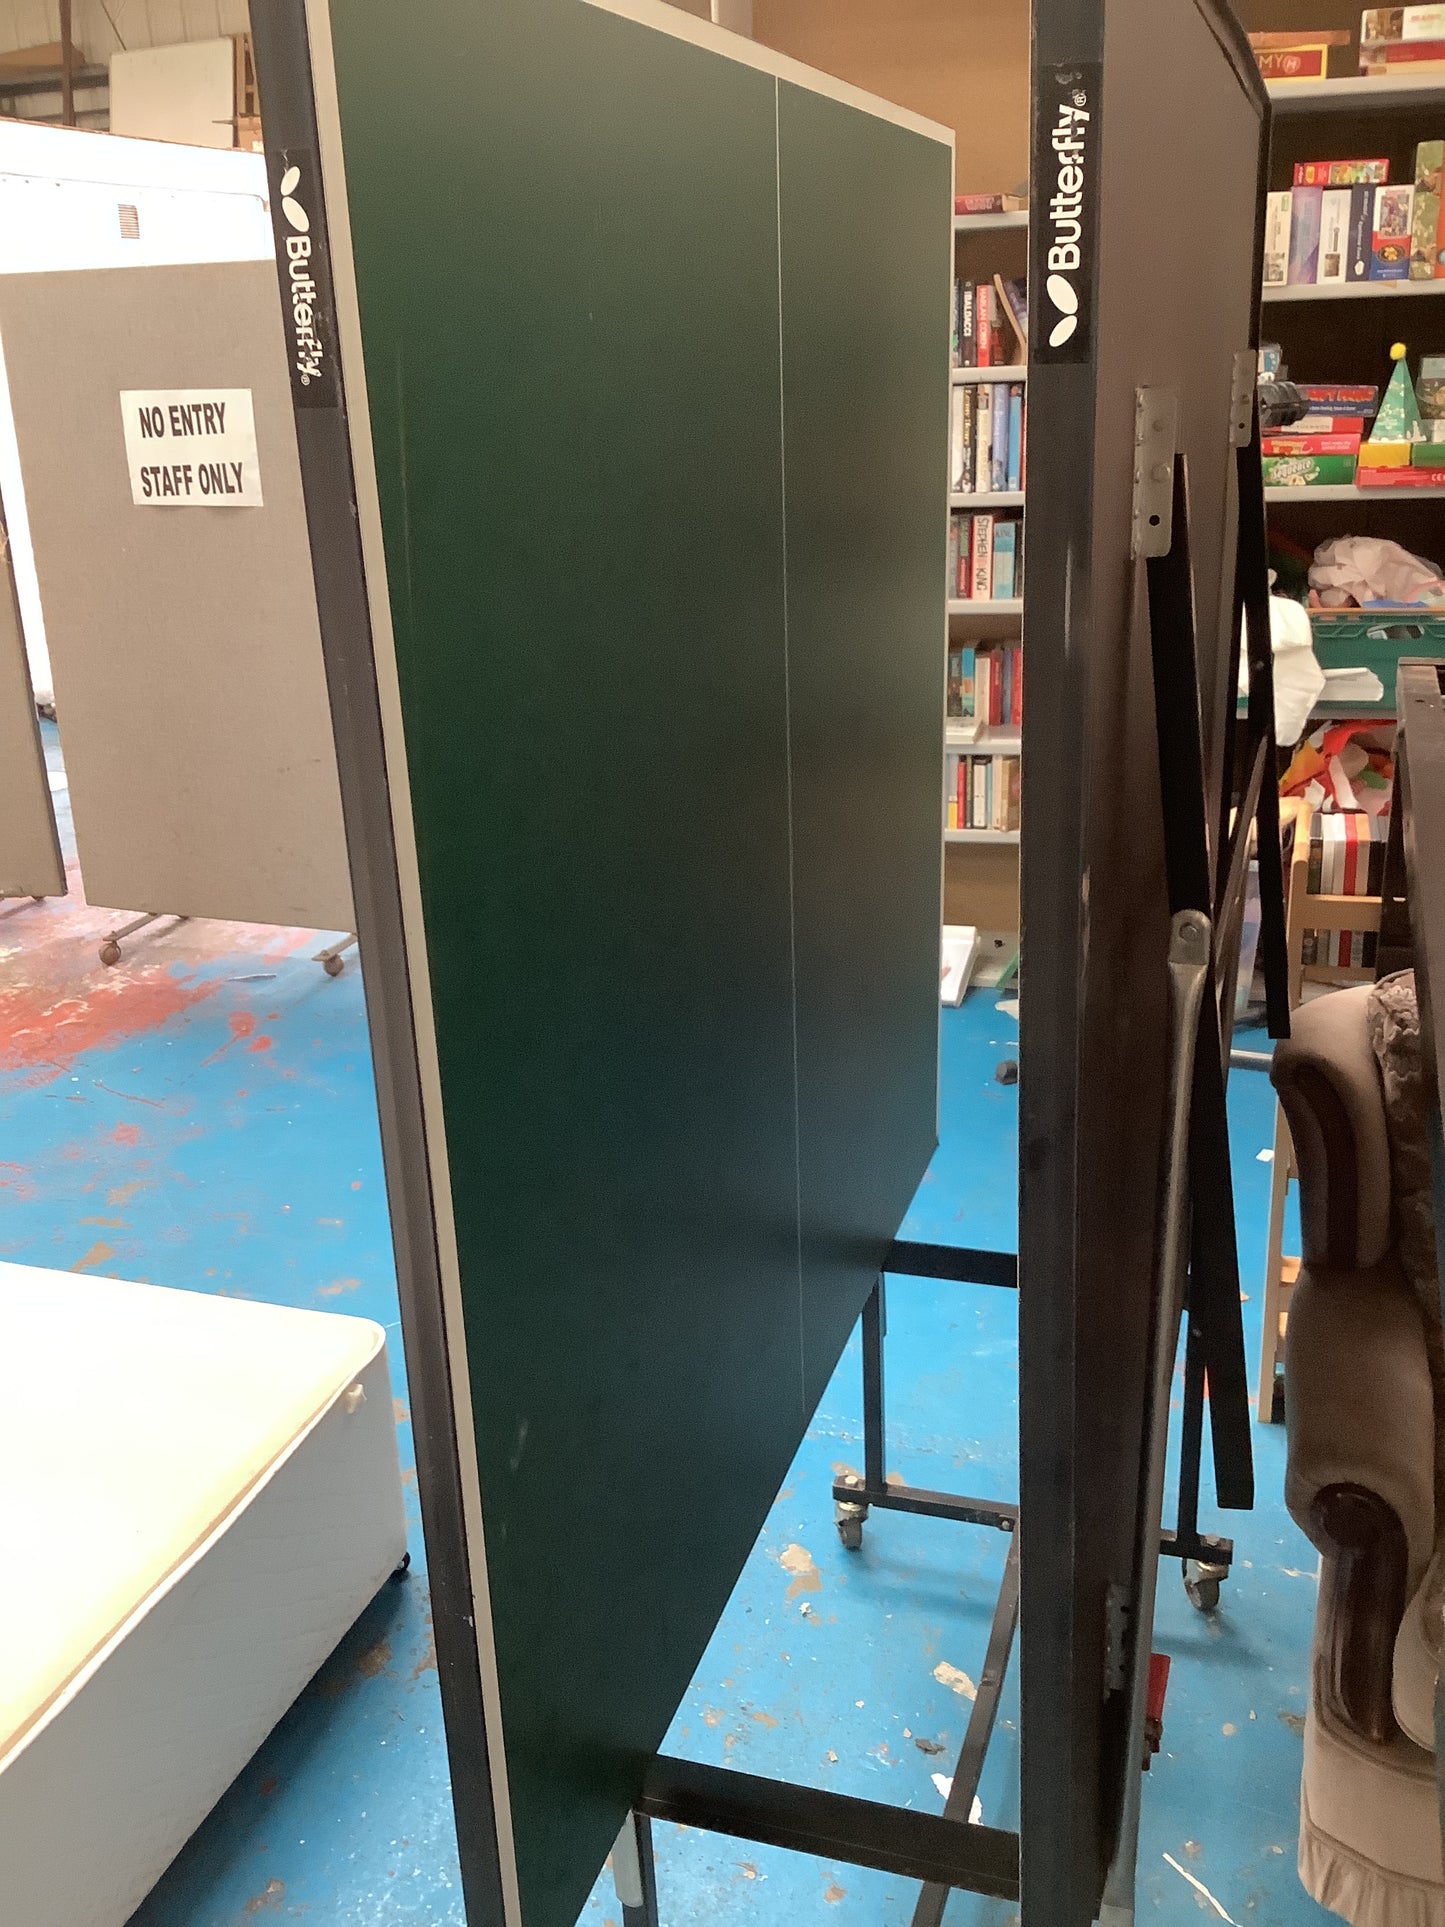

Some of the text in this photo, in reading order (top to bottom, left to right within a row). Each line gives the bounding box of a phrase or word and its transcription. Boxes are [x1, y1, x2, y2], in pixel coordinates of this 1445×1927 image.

[138, 402, 226, 439] NO ENTRY
[140, 461, 244, 498] STAFF ONLY
[976, 517, 989, 591] STEPHEN KING
